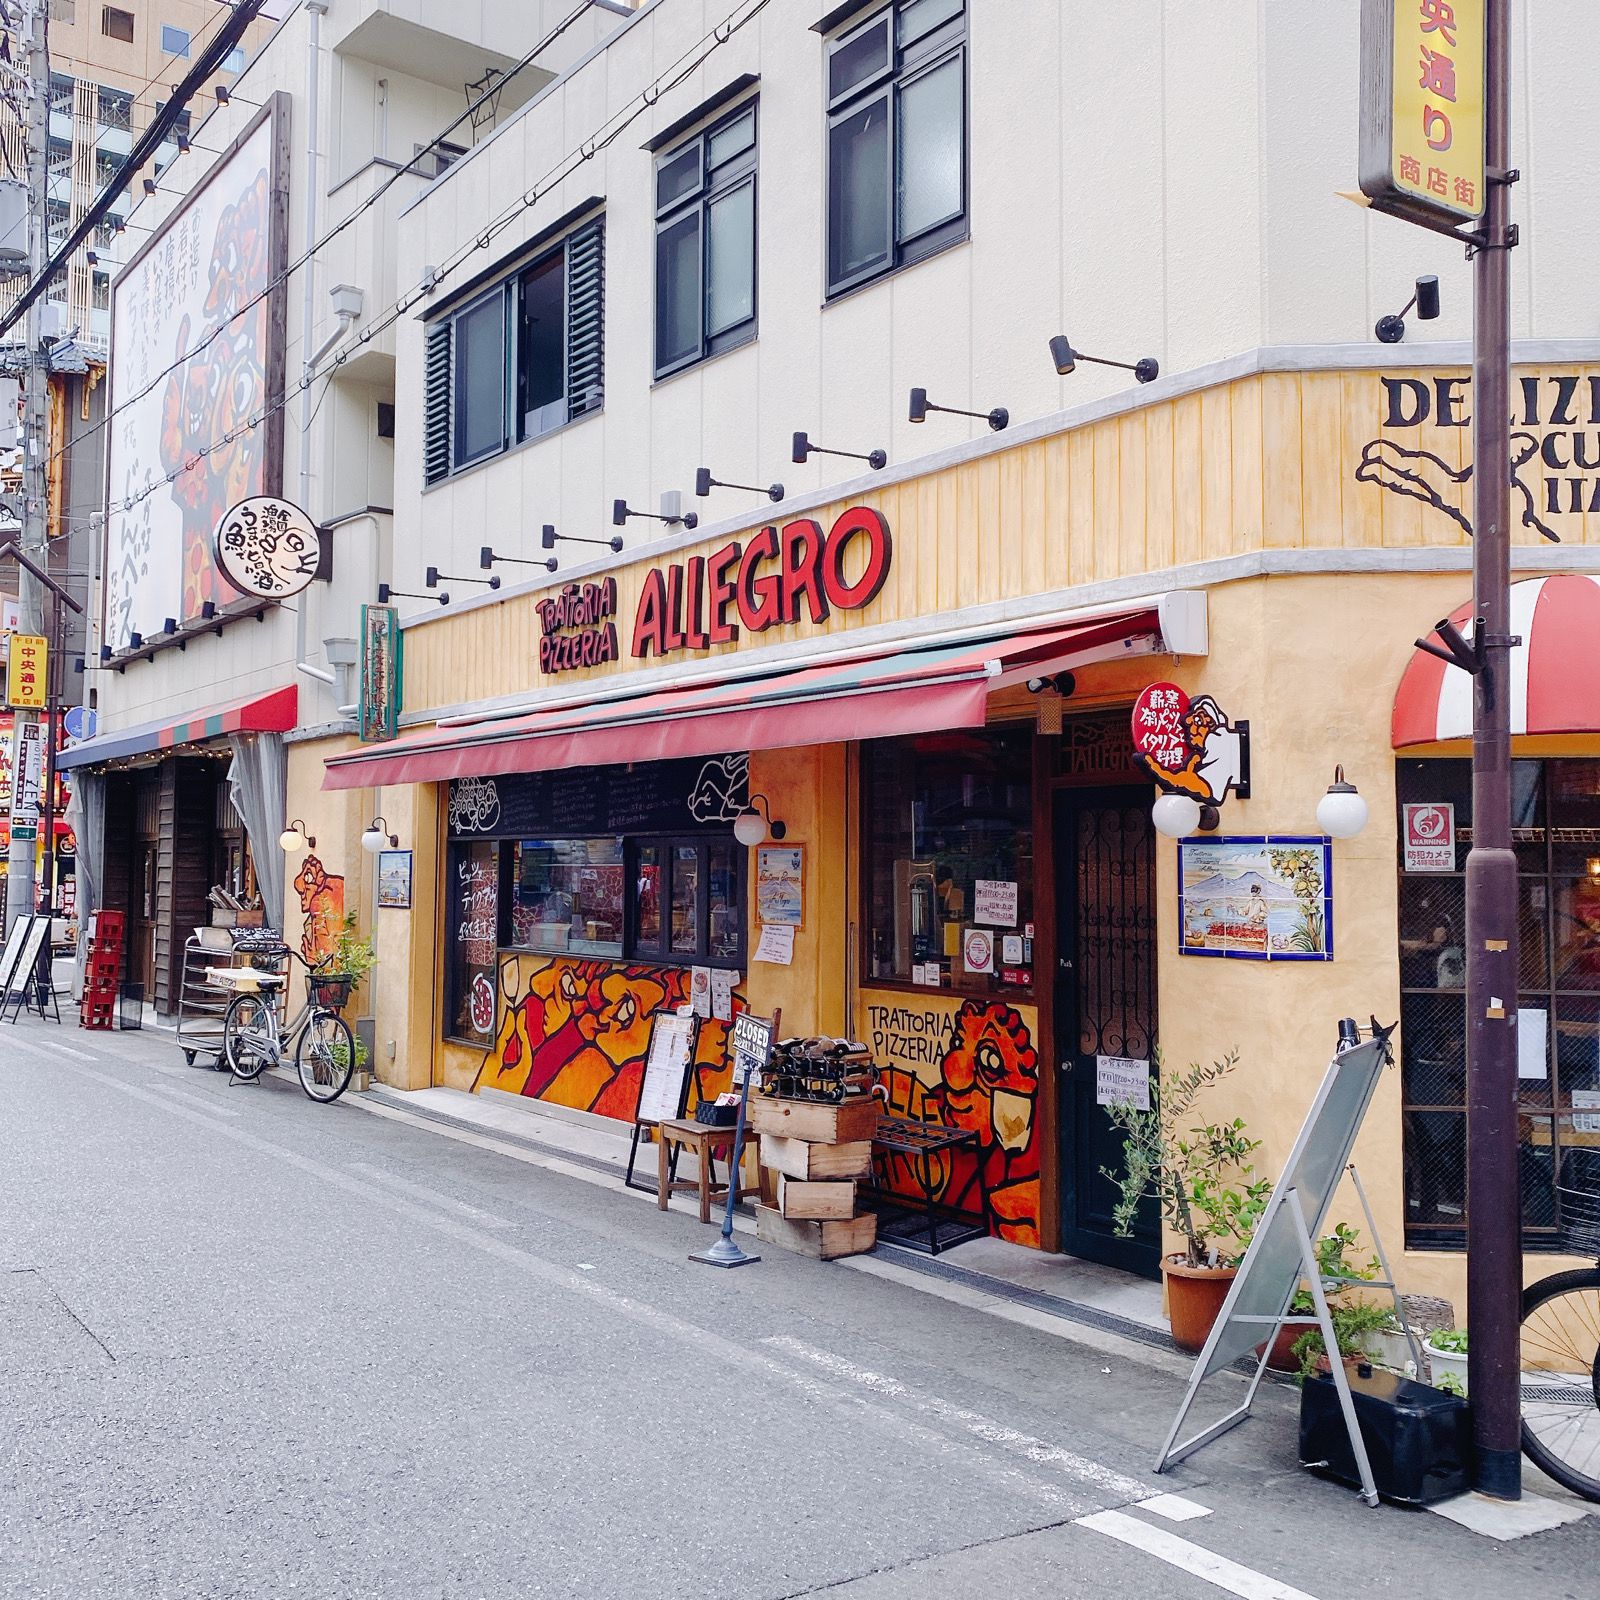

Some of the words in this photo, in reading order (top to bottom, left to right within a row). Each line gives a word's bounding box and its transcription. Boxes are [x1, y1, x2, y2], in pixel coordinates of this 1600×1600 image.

[1399, 154, 1475, 207] 商店街
[631, 506, 893, 658] ALLEGRO
[539, 622, 619, 674] PIZZERIA
[20, 647, 36, 696] 中央通り
[1156, 747, 1183, 767] 料理
[1408, 851, 1451, 859] 防犯カメラ
[735, 1019, 769, 1048] CLOSED
[873, 1031, 944, 1065] PIZZERIA
